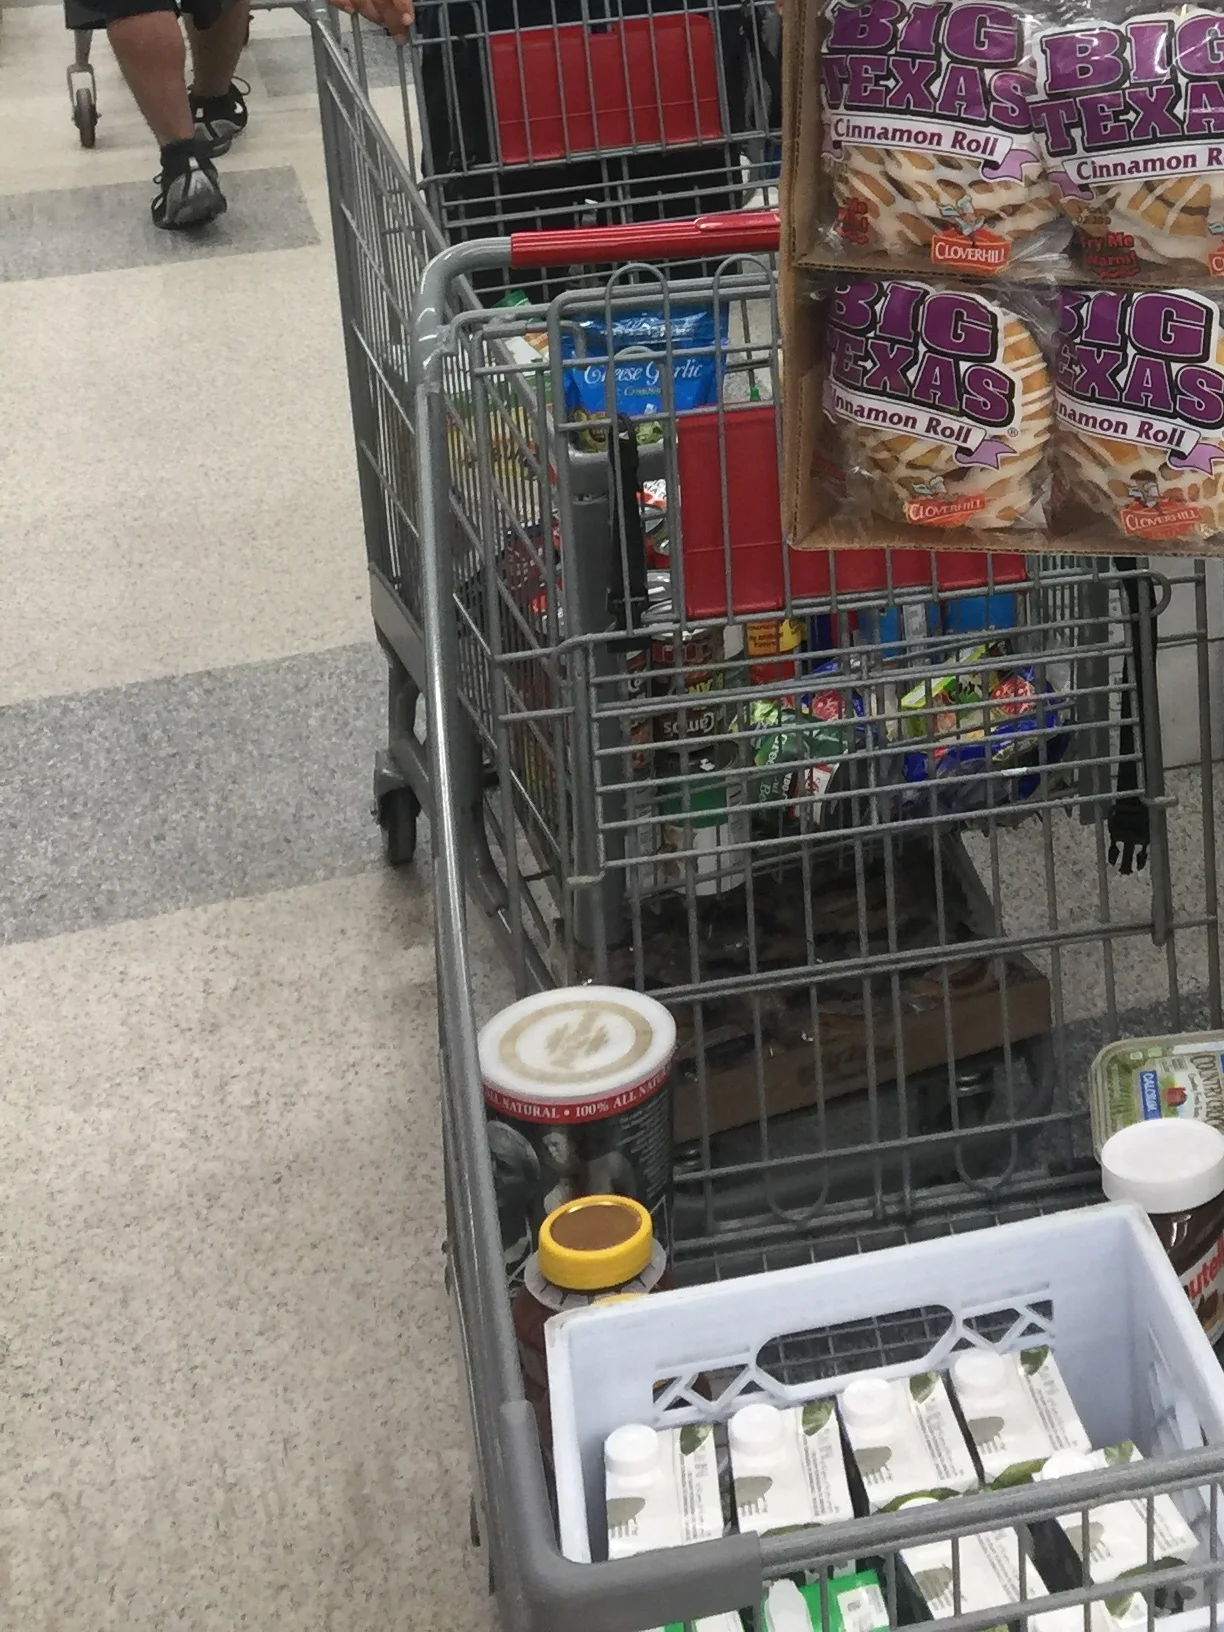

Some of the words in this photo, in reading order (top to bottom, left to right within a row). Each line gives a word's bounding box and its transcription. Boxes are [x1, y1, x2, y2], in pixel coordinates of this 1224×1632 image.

[822, 52, 1040, 131] TEXAS
[832, 114, 944, 152] Cinnamon
[950, 129, 1001, 158] Roll
[1076, 152, 1199, 182] Cinnamon
[934, 240, 1006, 264] CLOVERHILL
[829, 280, 1001, 360] BIG
[924, 414, 974, 446] Roll
[1136, 418, 1187, 449] Roll
[907, 496, 986, 523] CLOVERHILL
[1124, 506, 1202, 533] CLOVERHILL
[500, 1096, 561, 1120] NATURAL
[575, 1100, 611, 1118] 100%
[613, 1091, 638, 1109] ALL
[1142, 1072, 1158, 1113] CALCIUM
